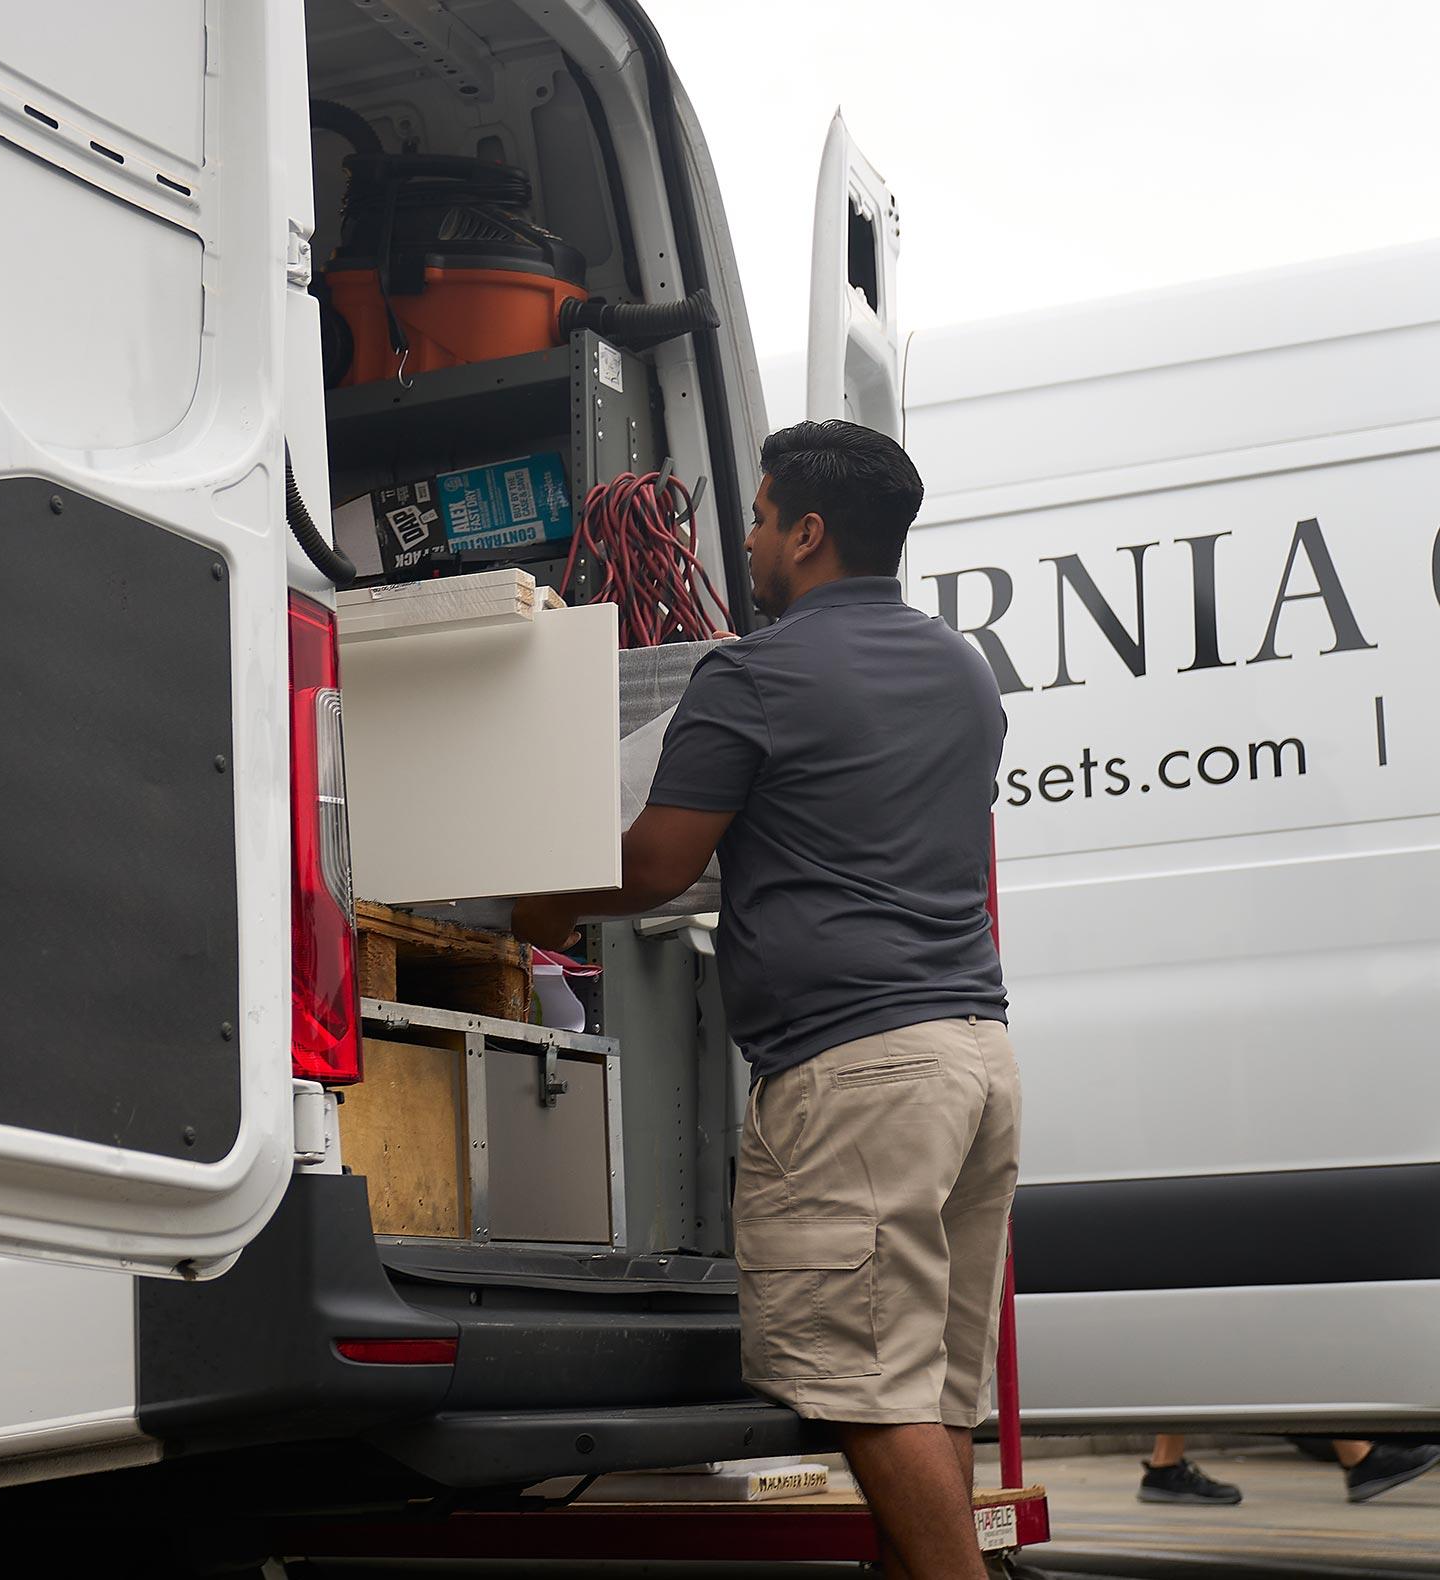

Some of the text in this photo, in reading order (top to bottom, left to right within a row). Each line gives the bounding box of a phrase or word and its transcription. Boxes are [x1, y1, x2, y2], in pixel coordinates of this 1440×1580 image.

[392, 511, 425, 544] DAP
[464, 488, 481, 531] FAST DRY
[991, 737, 1307, 806] sets.com
